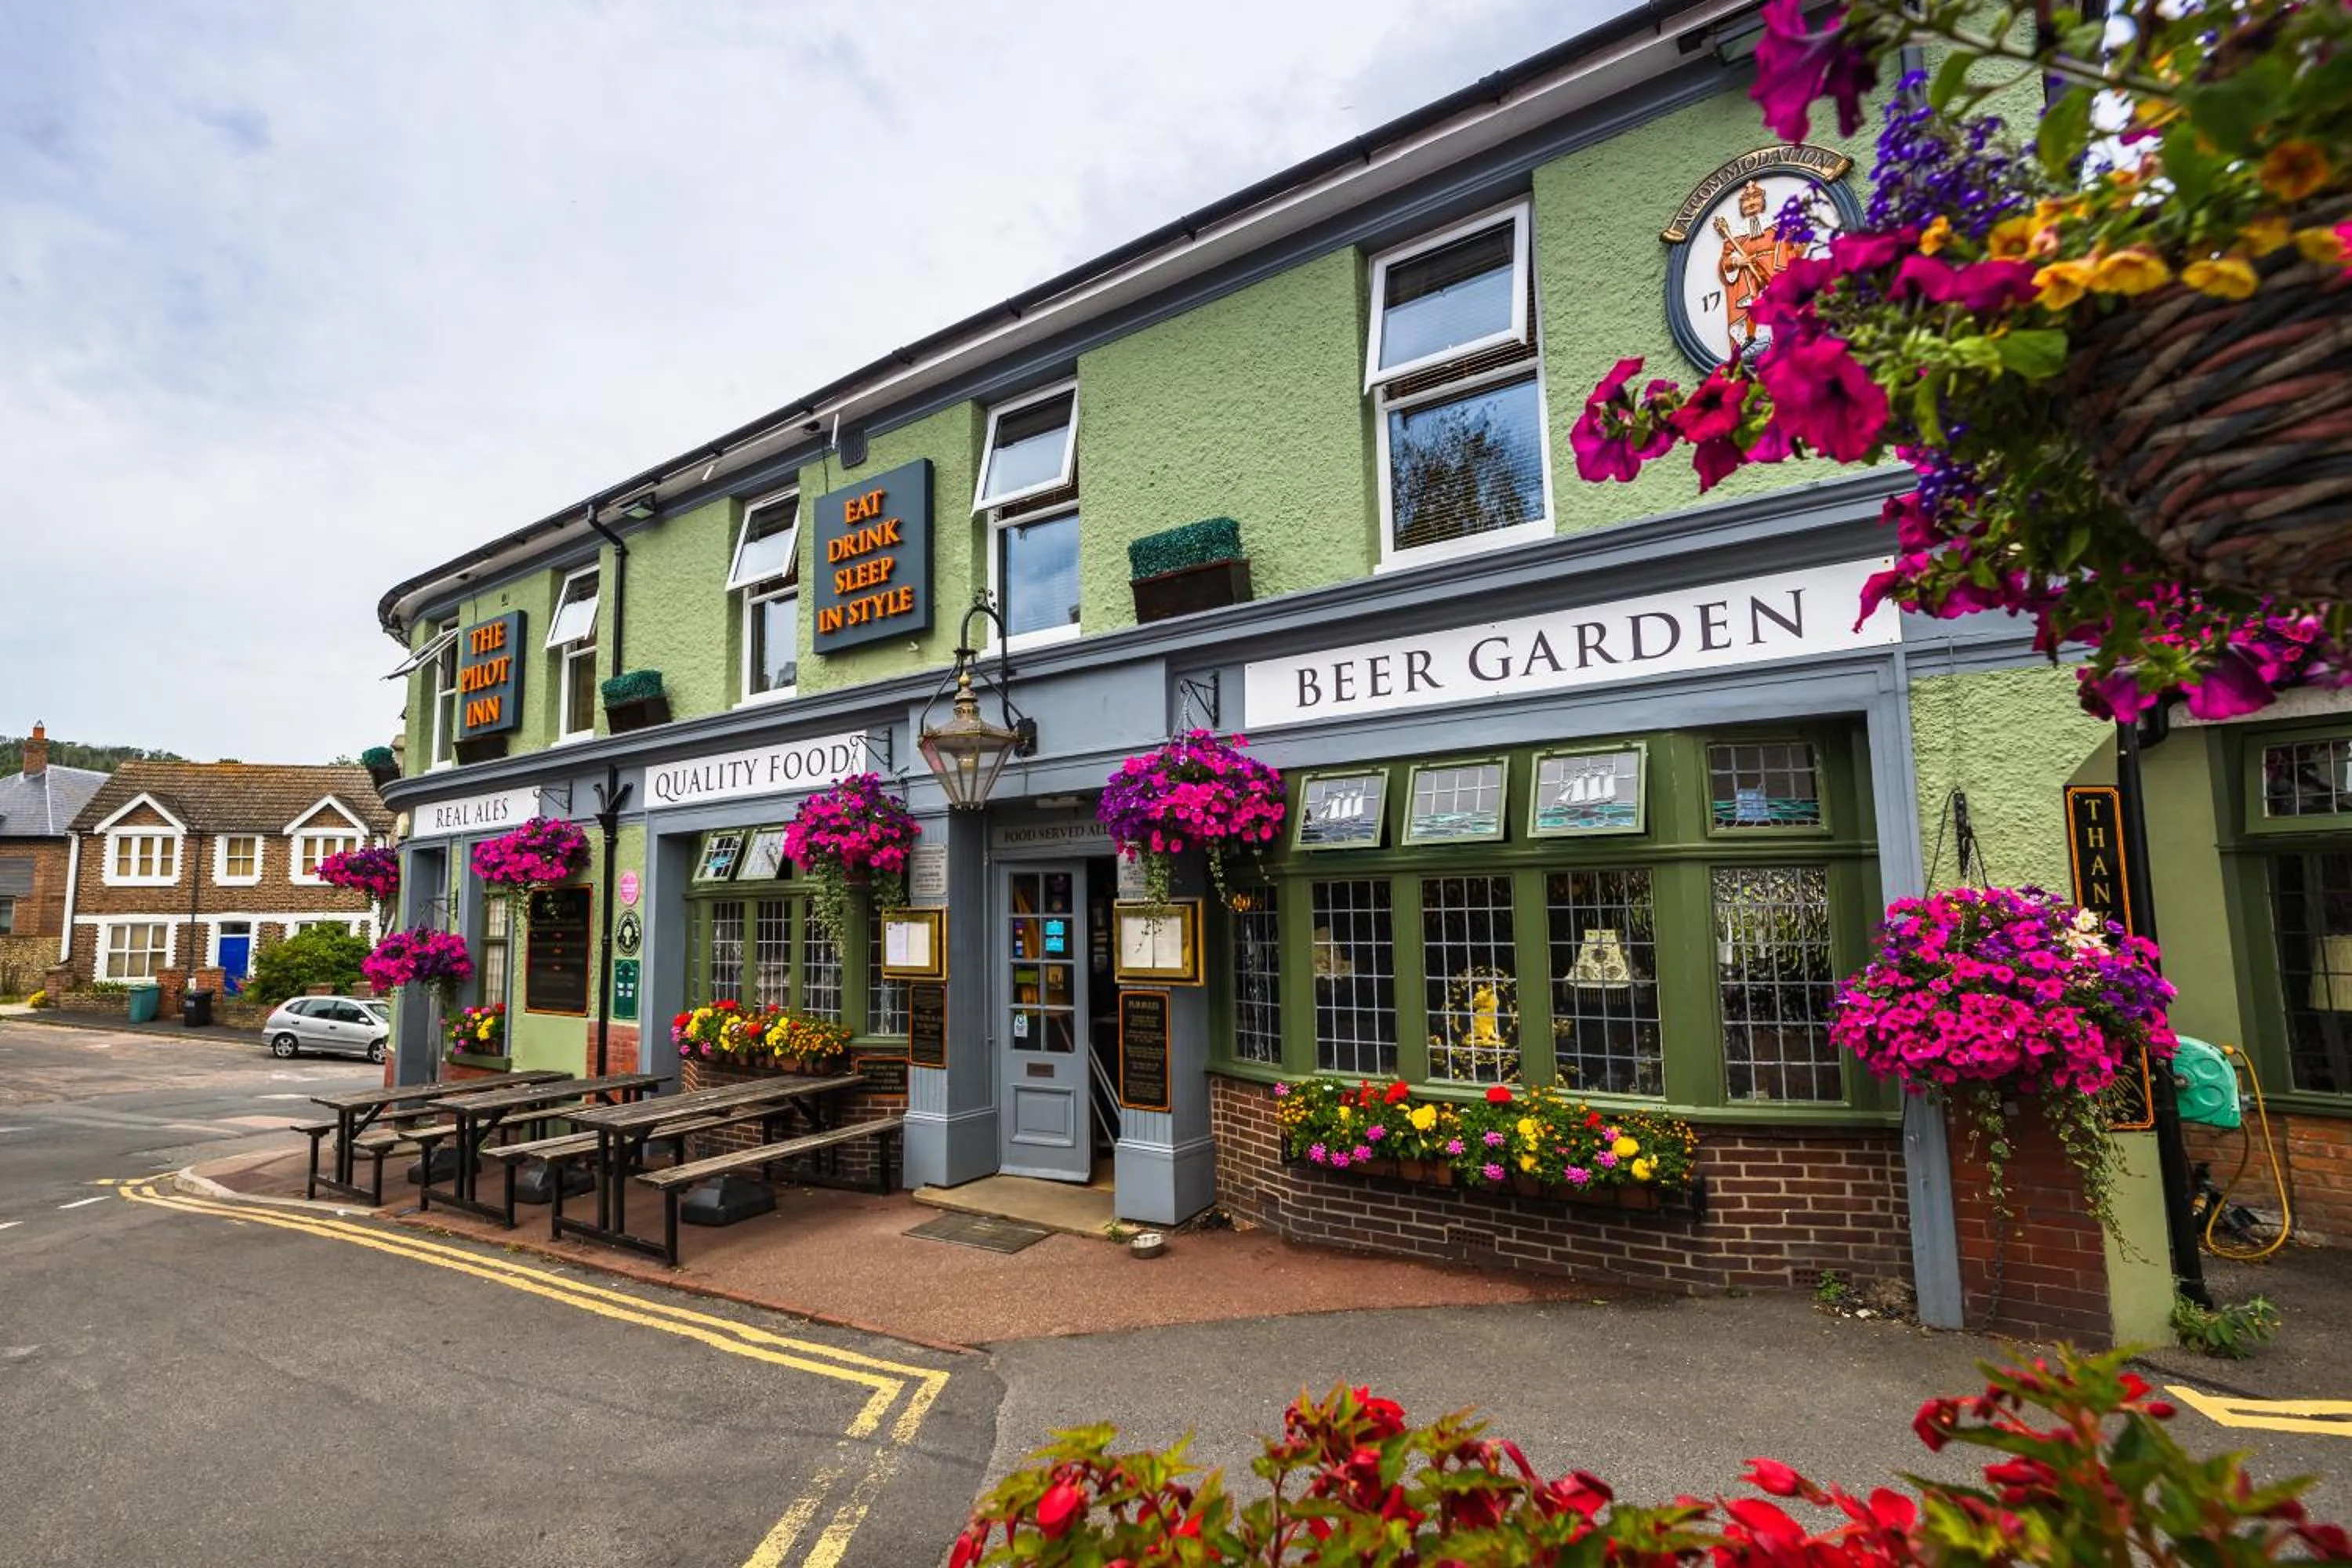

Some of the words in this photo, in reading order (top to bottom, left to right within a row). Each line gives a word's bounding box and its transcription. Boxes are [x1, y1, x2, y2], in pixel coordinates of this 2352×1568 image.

[1676, 145, 1833, 231] ACCOMMODATION
[844, 488, 884, 524] EAT
[827, 517, 902, 564] DRINK
[834, 556, 894, 596] SLEEP
[818, 604, 844, 633] IN
[848, 586, 913, 626] STYLE
[470, 621, 504, 655] THE
[1294, 649, 1443, 708] BEER
[1468, 588, 1806, 682] GARDEN
[460, 655, 511, 692] PILOT
[466, 695, 502, 728] INN
[655, 758, 758, 802] QUALITY
[769, 744, 850, 782] FOOD
[436, 804, 469, 829] REAL
[474, 797, 509, 824] ALES
[1004, 828, 1036, 843] FOOD
[1039, 825, 1084, 840] SERVED
